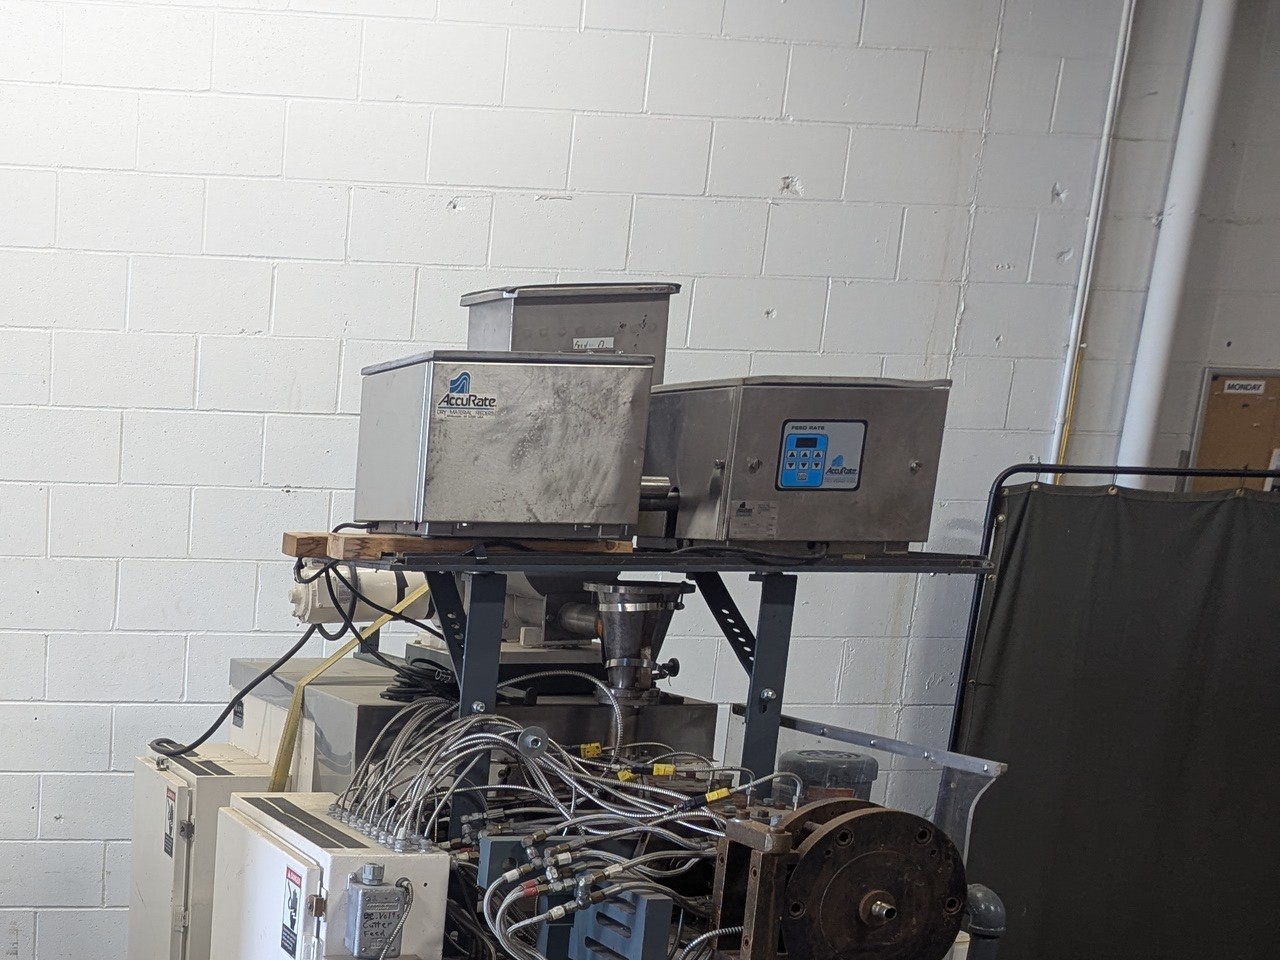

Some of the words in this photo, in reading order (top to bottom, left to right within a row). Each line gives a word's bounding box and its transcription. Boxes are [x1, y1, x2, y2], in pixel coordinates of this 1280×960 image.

[1226, 383, 1262, 391] MONDAY
[437, 393, 497, 407] AccuRate
[825, 466, 858, 475] AccuRate
[362, 920, 393, 929] Cutter
[363, 930, 386, 938] Feed
